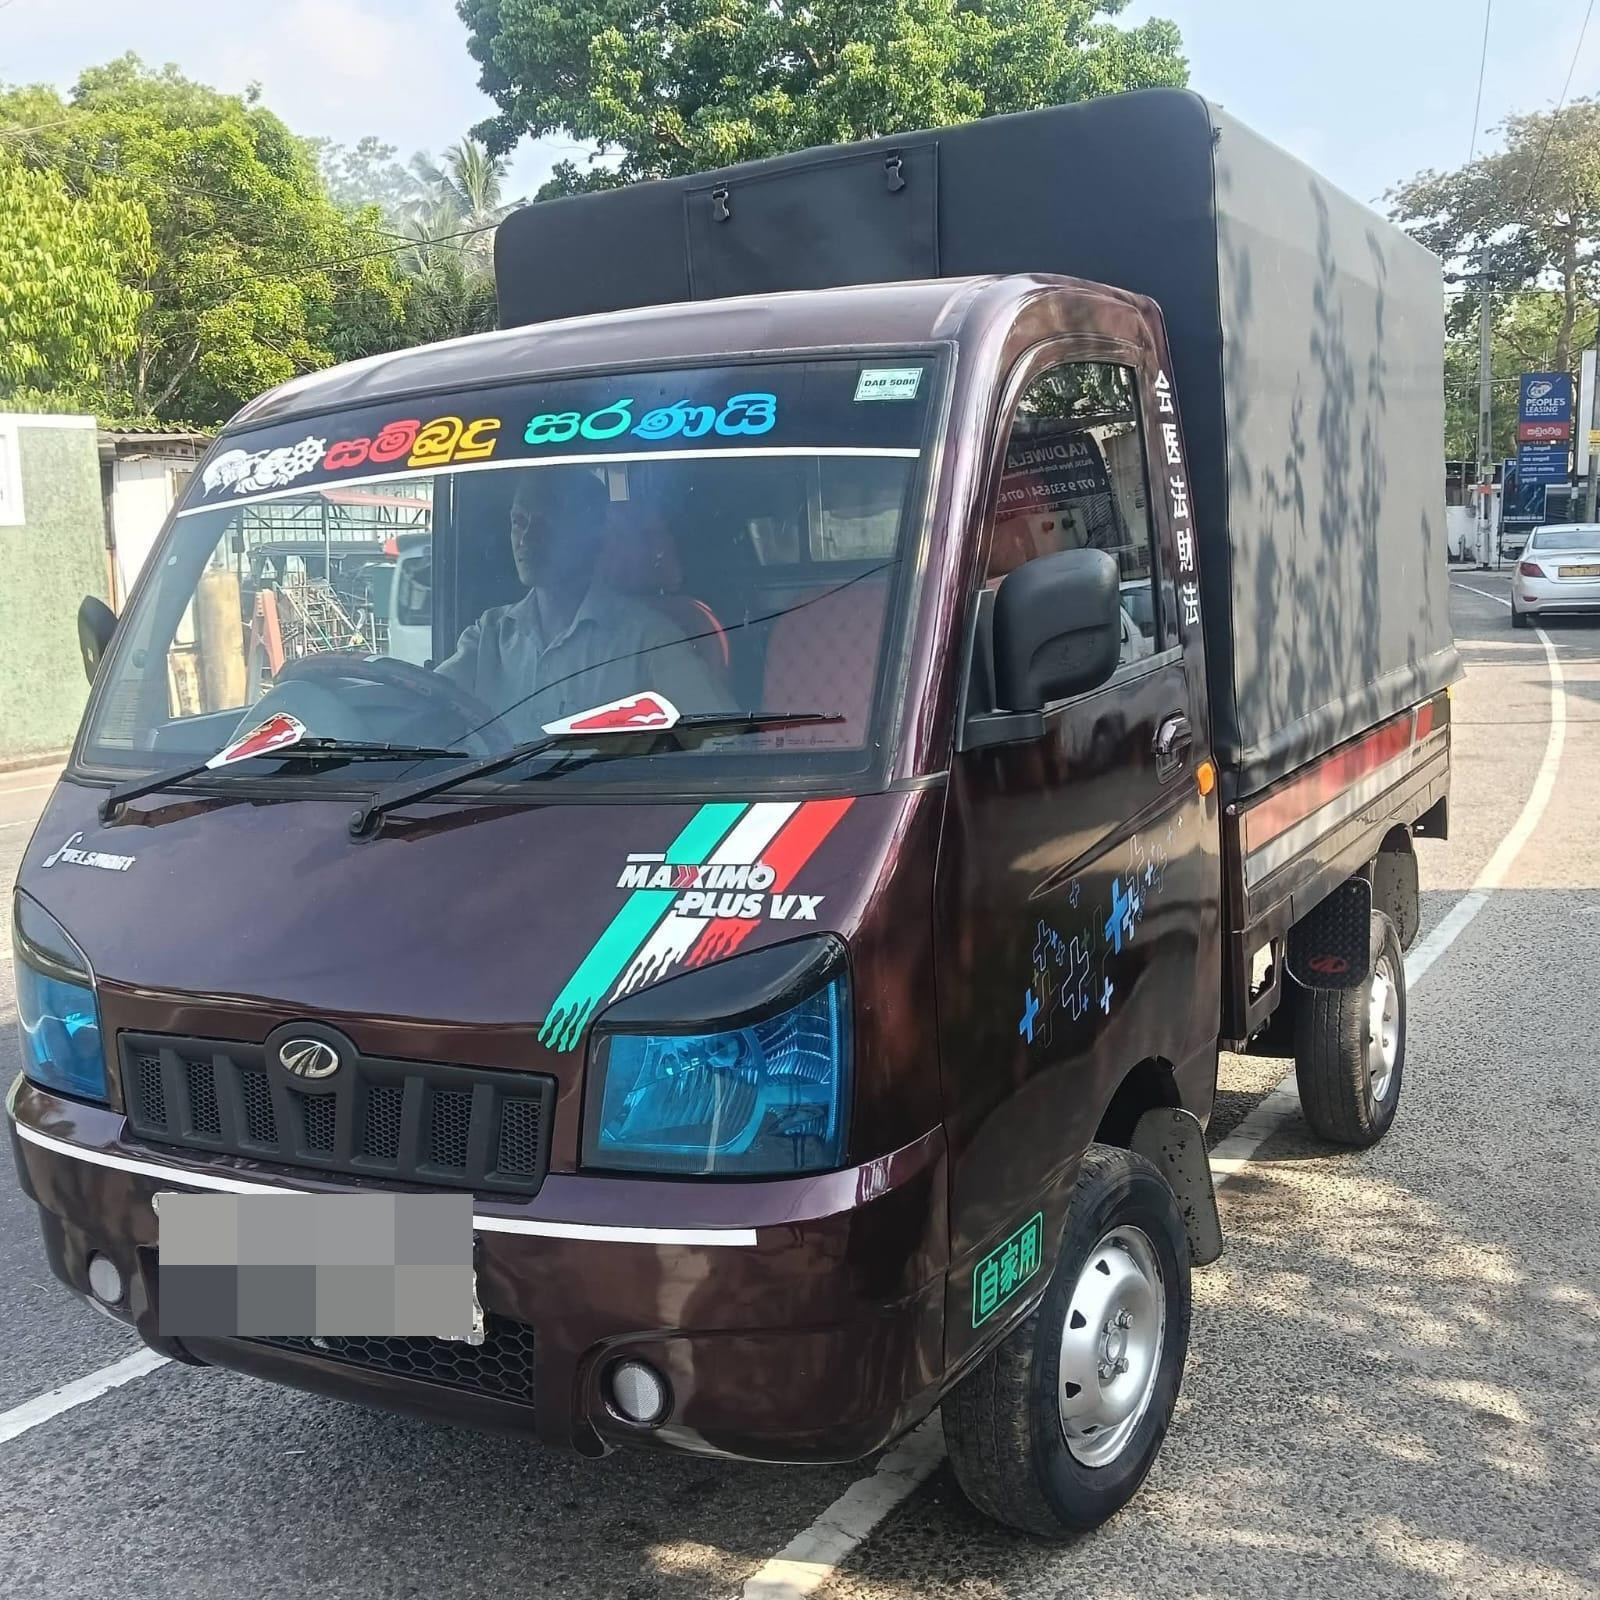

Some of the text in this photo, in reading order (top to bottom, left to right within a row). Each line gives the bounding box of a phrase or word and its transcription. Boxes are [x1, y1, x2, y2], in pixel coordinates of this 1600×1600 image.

[323, 392, 777, 471] සම්බුදු සරණයි
[616, 861, 776, 891] MAXIMO
[674, 891, 826, 921] PLUS VX
[980, 1224, 1037, 1314] 自家用
